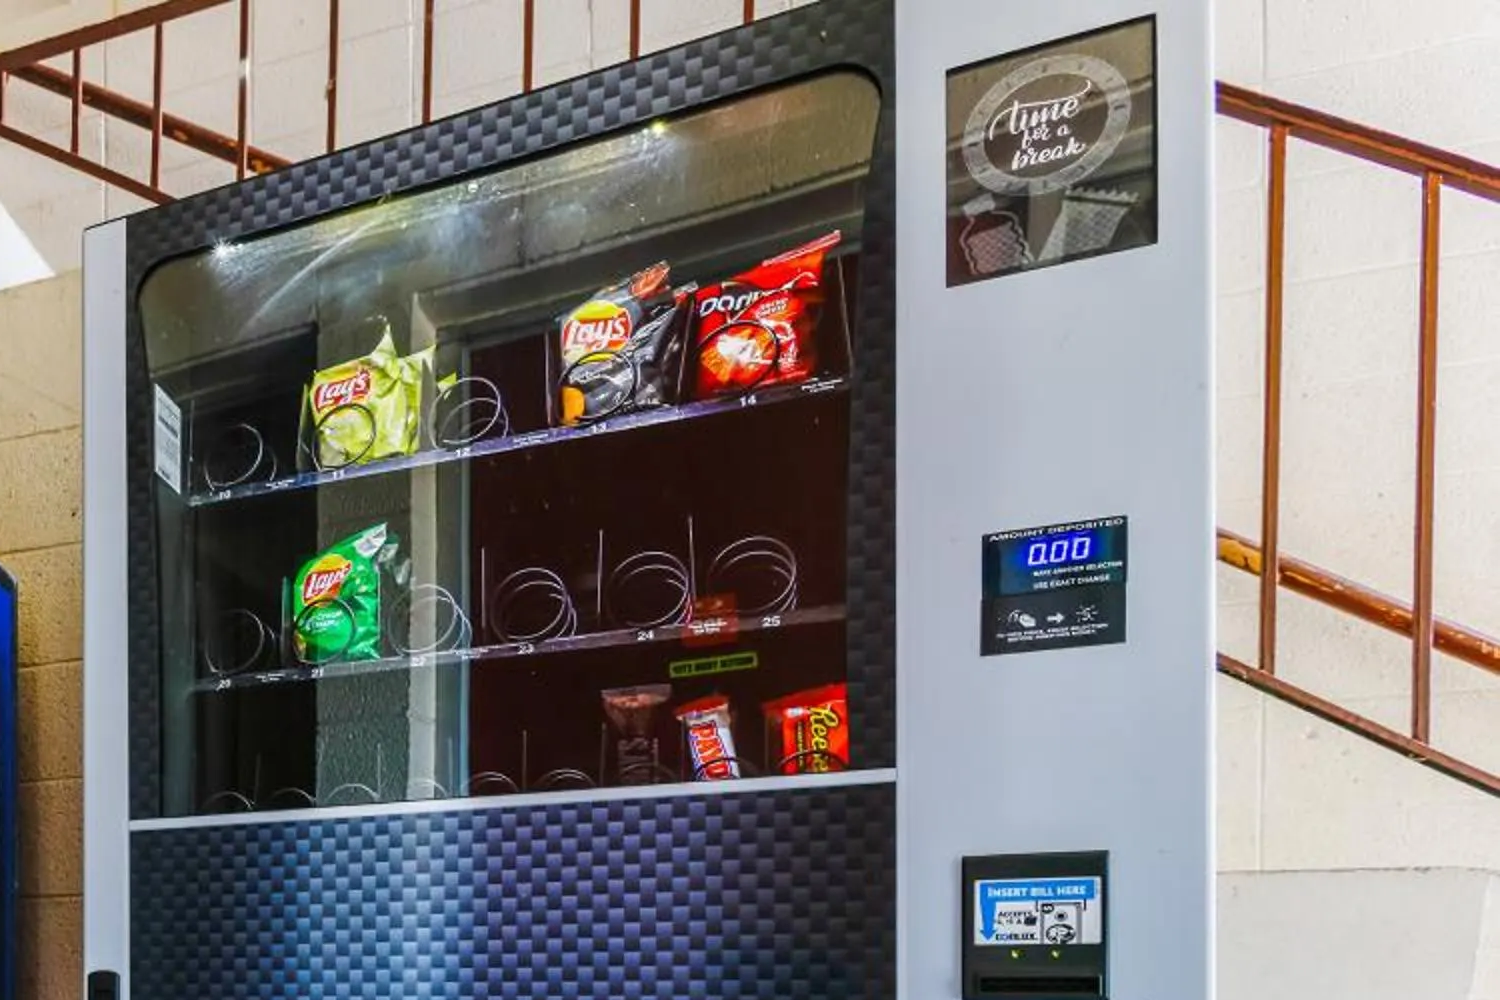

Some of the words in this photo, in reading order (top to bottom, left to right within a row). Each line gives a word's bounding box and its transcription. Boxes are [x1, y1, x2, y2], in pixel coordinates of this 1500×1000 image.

[1021, 125, 1051, 150] for
[1057, 124, 1072, 137] a
[1011, 137, 1086, 171] break
[740, 395, 757, 407] 14
[989, 527, 1044, 542] AMOUNT
[1048, 517, 1124, 534] DEPOSITED
[1028, 537, 1091, 566] 0.00
[1050, 577, 1076, 588] EXACT
[1077, 573, 1111, 584] CHANGE
[761, 615, 781, 628] 25
[636, 630, 654, 641] 24
[988, 887, 1028, 898] INSERT
[1030, 886, 1054, 897] BILL
[1056, 885, 1087, 896] HERE
